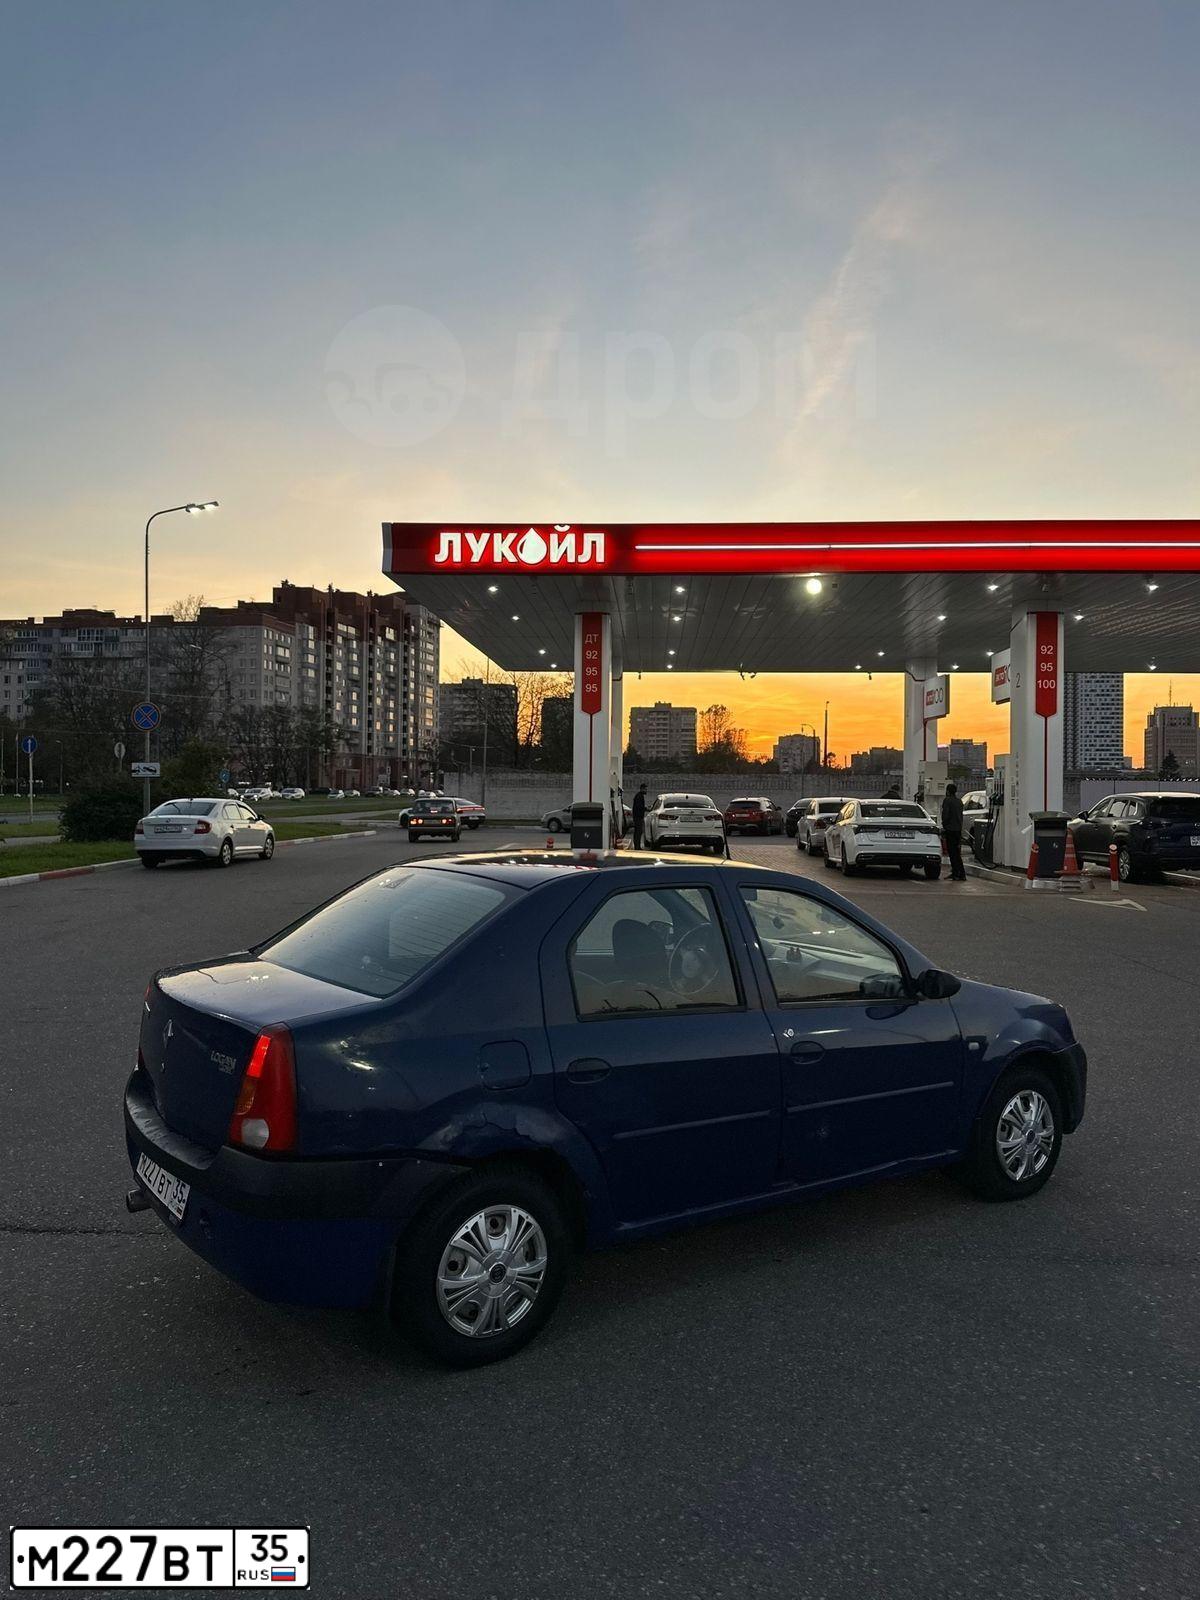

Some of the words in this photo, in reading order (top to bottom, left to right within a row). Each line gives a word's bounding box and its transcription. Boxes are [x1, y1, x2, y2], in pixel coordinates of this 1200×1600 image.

[434, 524, 605, 565] ЛУКОЙЛ
[585, 634, 599, 644] ДТ
[585, 650, 598, 659] 92
[1040, 645, 1054, 655] 92
[585, 667, 598, 676] 95
[1040, 662, 1053, 672] 95
[585, 684, 598, 693] 95
[1037, 679, 1056, 689] 100
